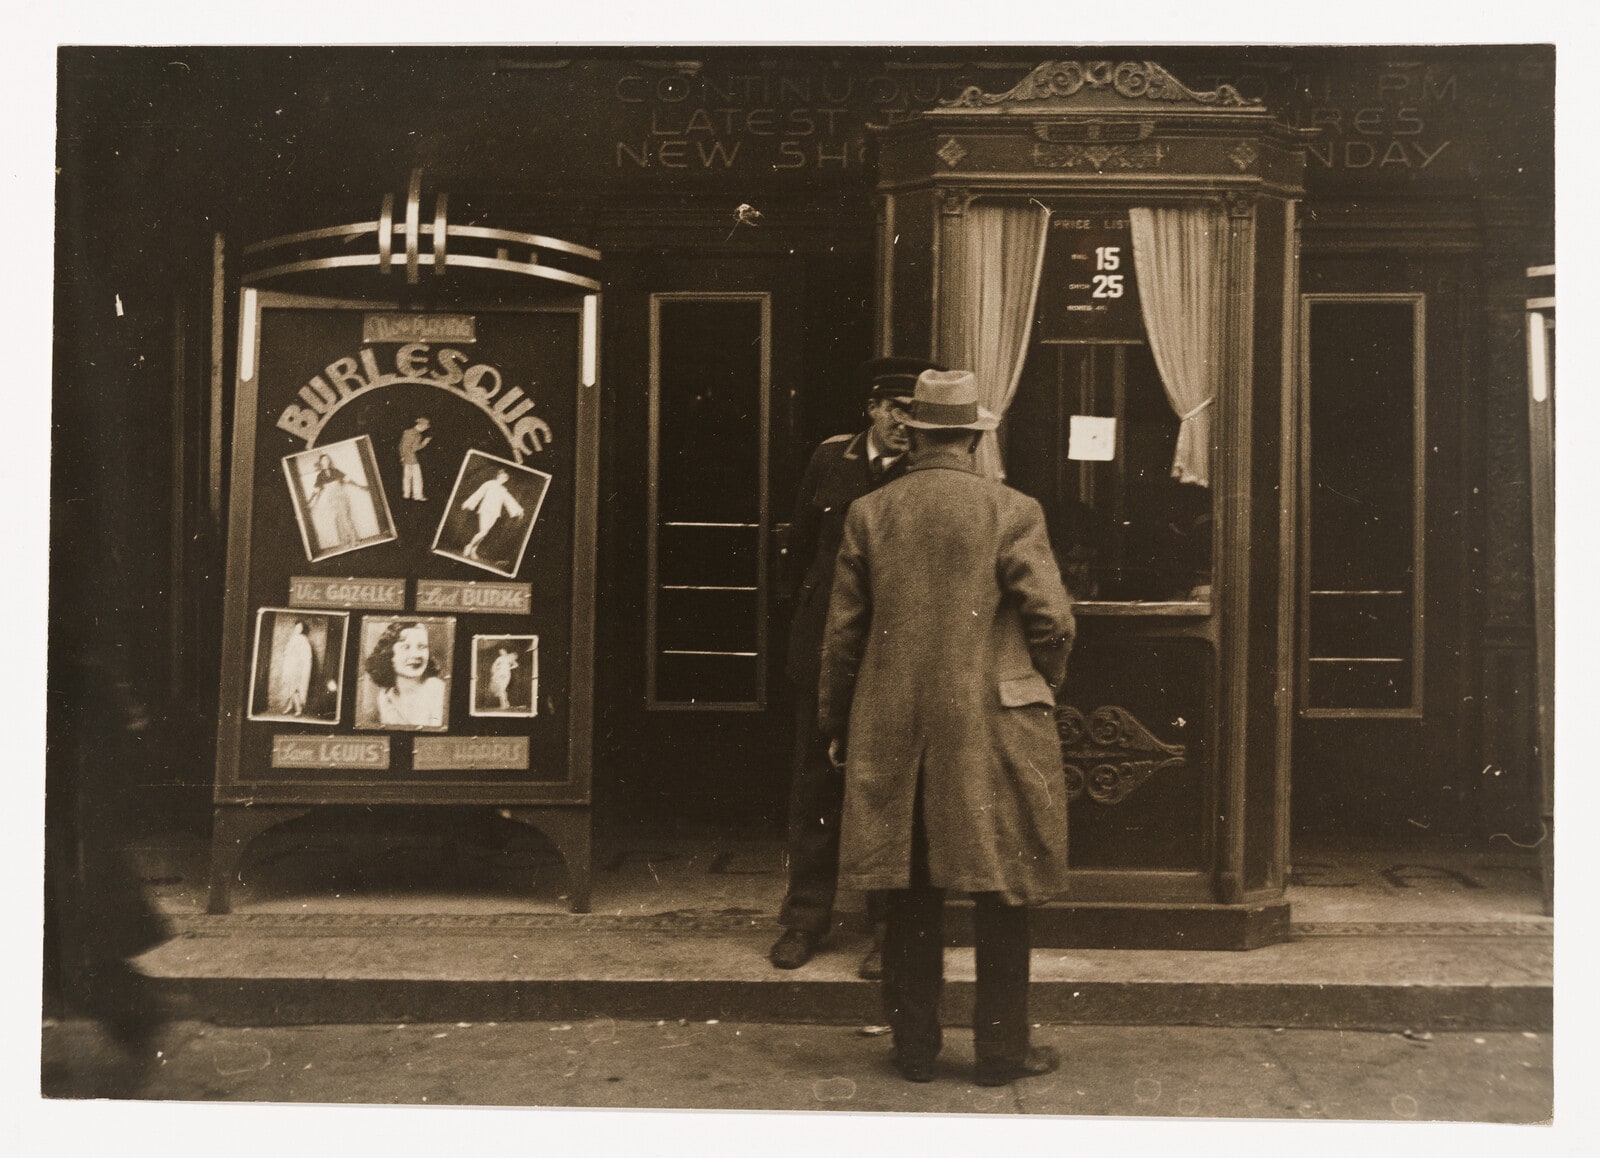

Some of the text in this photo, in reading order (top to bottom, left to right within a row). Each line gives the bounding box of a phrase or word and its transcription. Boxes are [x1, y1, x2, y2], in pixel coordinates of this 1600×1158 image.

[651, 107, 848, 136] LATEST
[615, 140, 742, 169] NEW
[1307, 140, 1451, 169] NDAY
[1053, 219, 1091, 230] PRICE
[1095, 246, 1121, 271] 15
[1091, 274, 1125, 299] 25
[275, 342, 554, 455] BURLESQUE
[326, 584, 396, 602] GAZELLE
[319, 743, 381, 763] LEWIS
